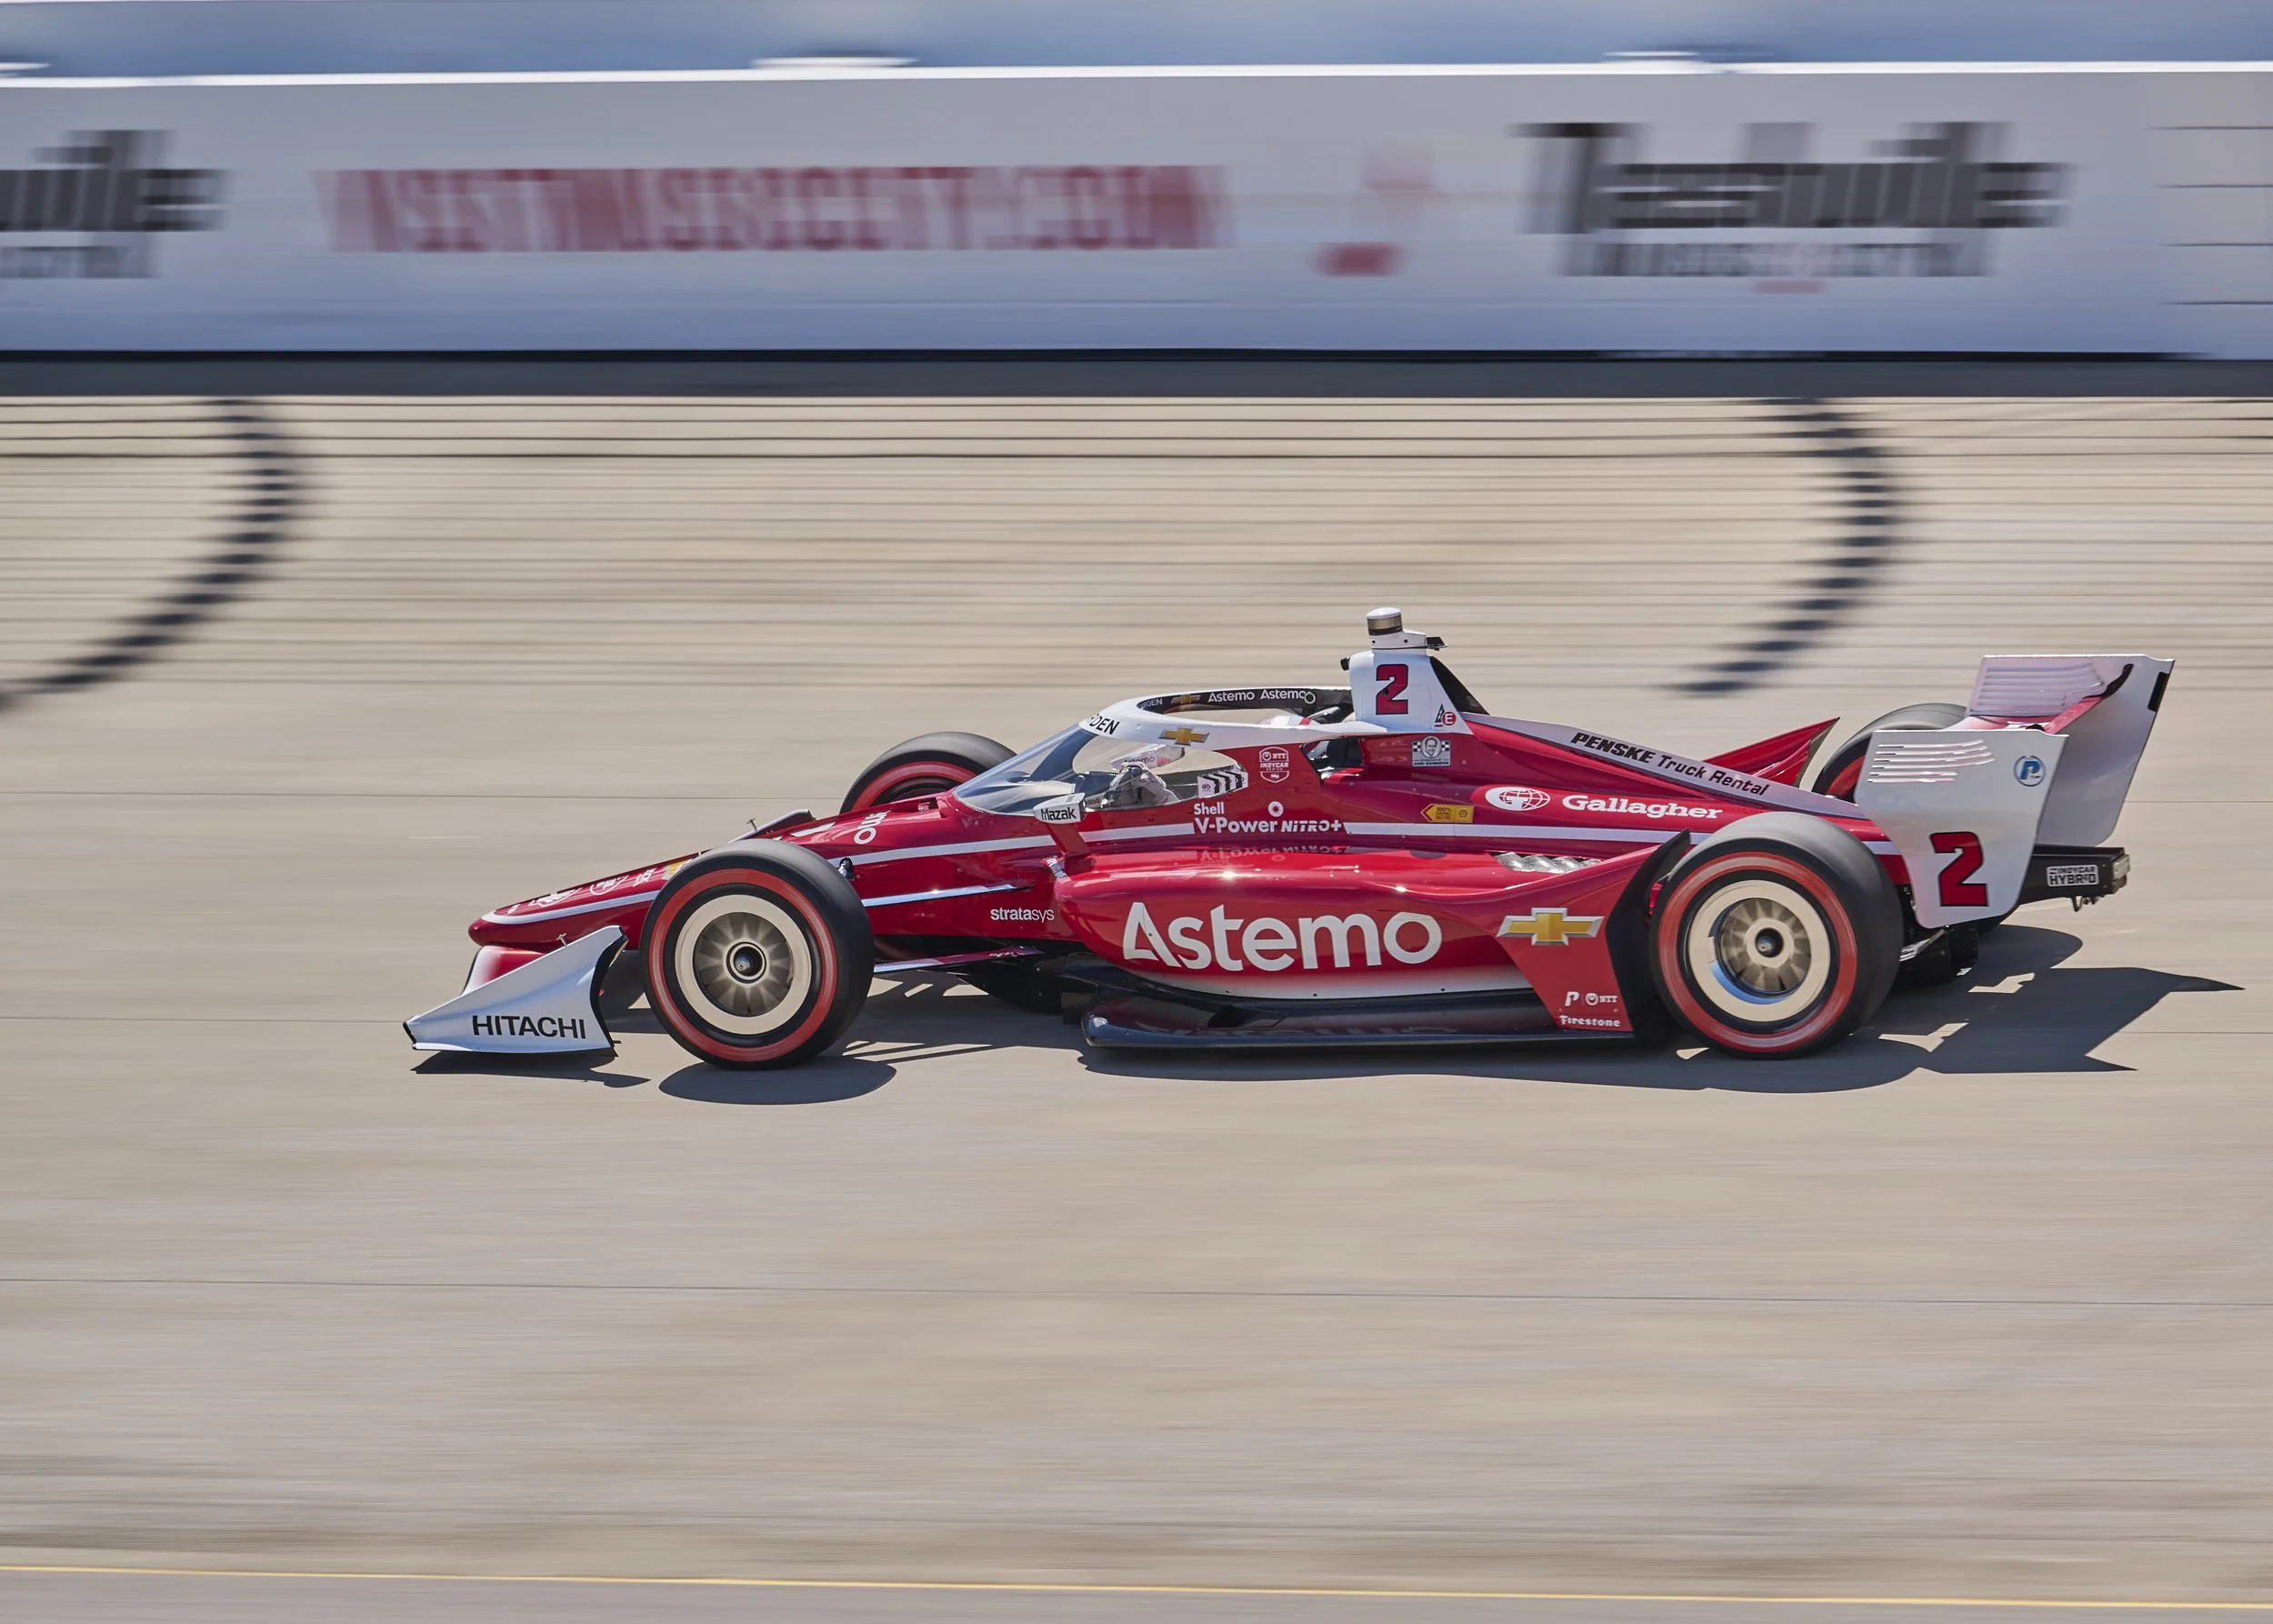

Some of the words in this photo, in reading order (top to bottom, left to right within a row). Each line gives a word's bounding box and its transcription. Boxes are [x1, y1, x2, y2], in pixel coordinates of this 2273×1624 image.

[1207, 691, 1256, 703] Astemo
[1376, 663, 1409, 716] 2
[1088, 713, 1120, 735] DEN
[1445, 713, 1454, 725] E
[1570, 732, 1656, 764] PENSKE
[1657, 755, 1707, 779] Truck
[1708, 770, 1771, 796] Rental
[1040, 807, 1077, 821] Mazak
[1194, 801, 1225, 816] Shell
[1562, 794, 1723, 818] Gallagher
[1195, 817, 1278, 834] V-Power
[1929, 831, 1990, 907] 2
[990, 907, 1055, 924] stratasys
[1122, 901, 1443, 972] Astemo
[472, 1015, 586, 1039] HITACHI
[1558, 1014, 1622, 1028] Firestone
